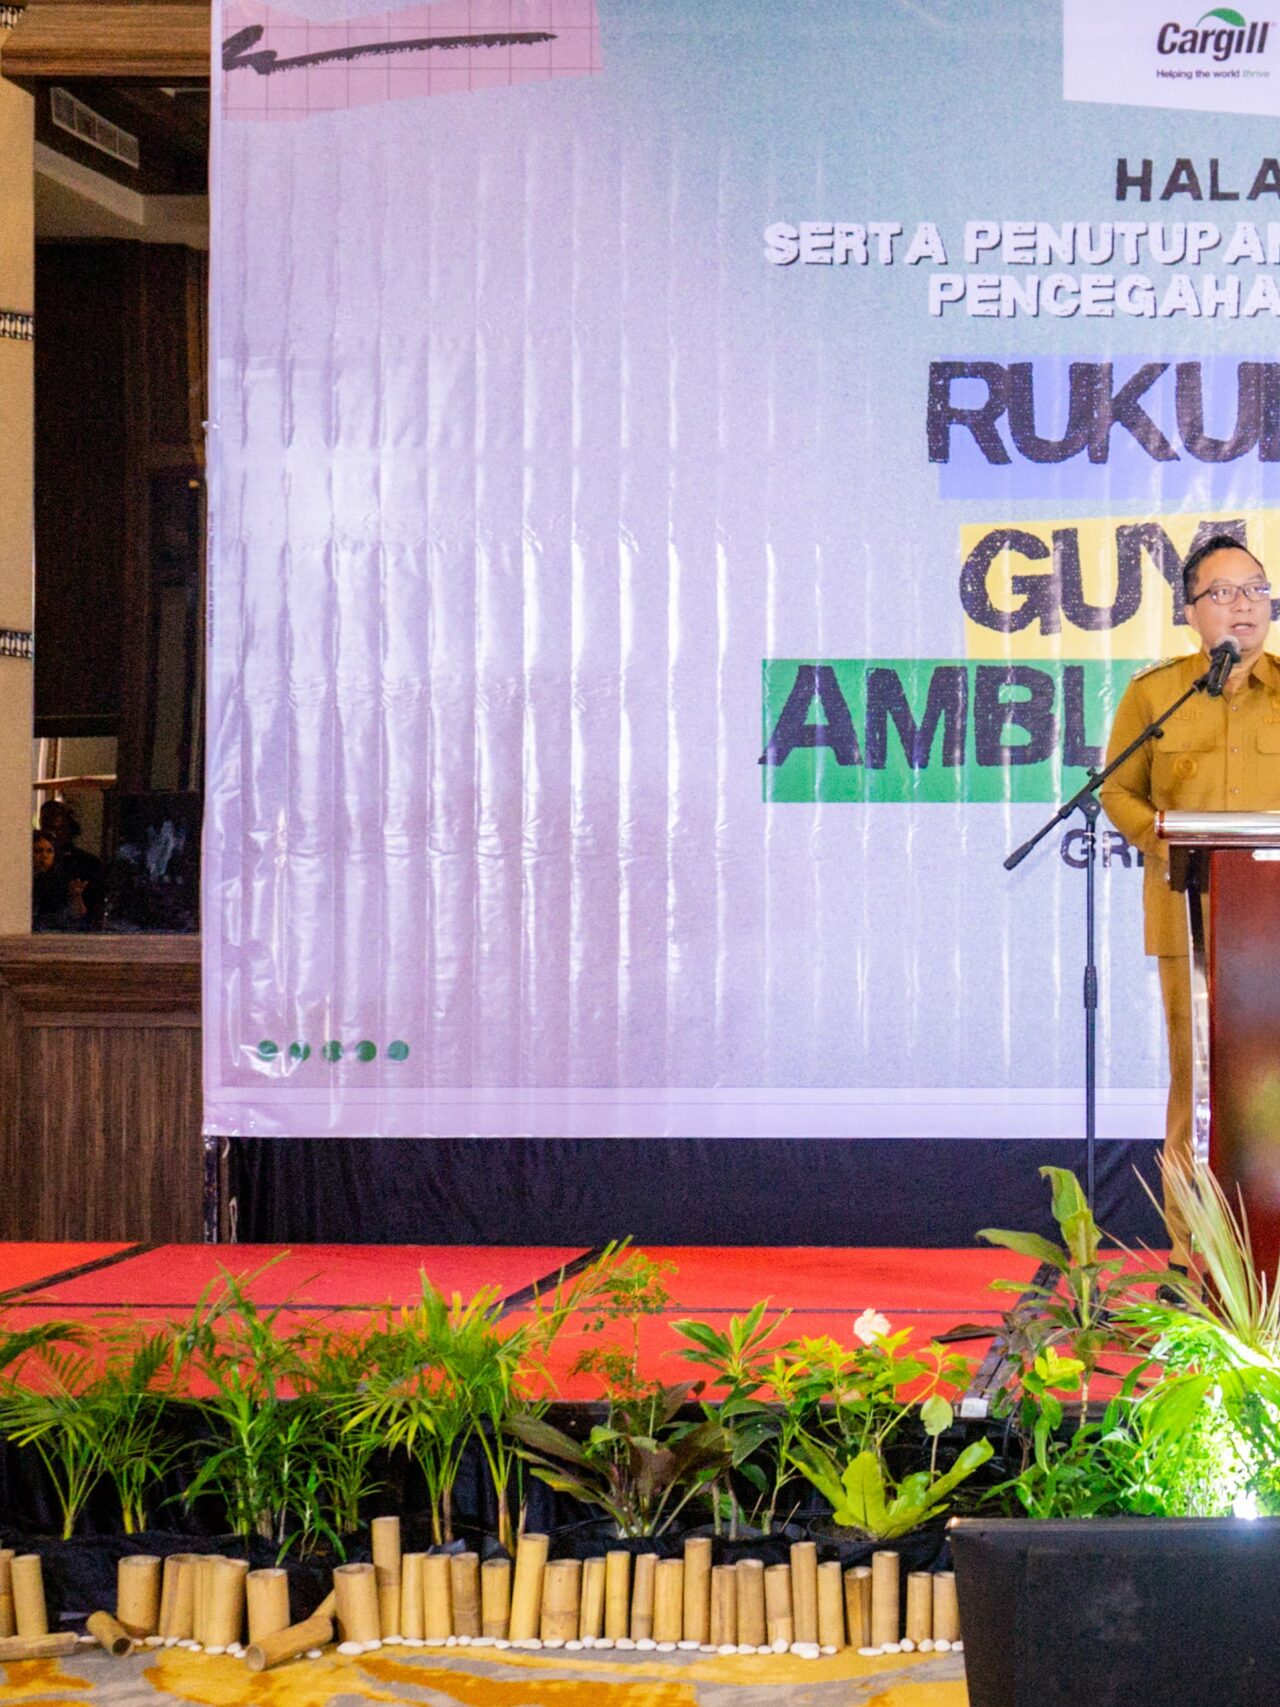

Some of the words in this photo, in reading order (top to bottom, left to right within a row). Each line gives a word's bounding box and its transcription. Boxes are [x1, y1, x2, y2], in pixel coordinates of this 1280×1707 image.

[1157, 22, 1269, 61] Cargill
[1156, 70, 1193, 79] Helping
[1195, 70, 1210, 78] the
[1213, 70, 1240, 78] world
[1242, 70, 1270, 78] thrive
[764, 221, 947, 265] SERTA
[759, 664, 1105, 769] AMBL
[1061, 828, 1144, 869] GR
